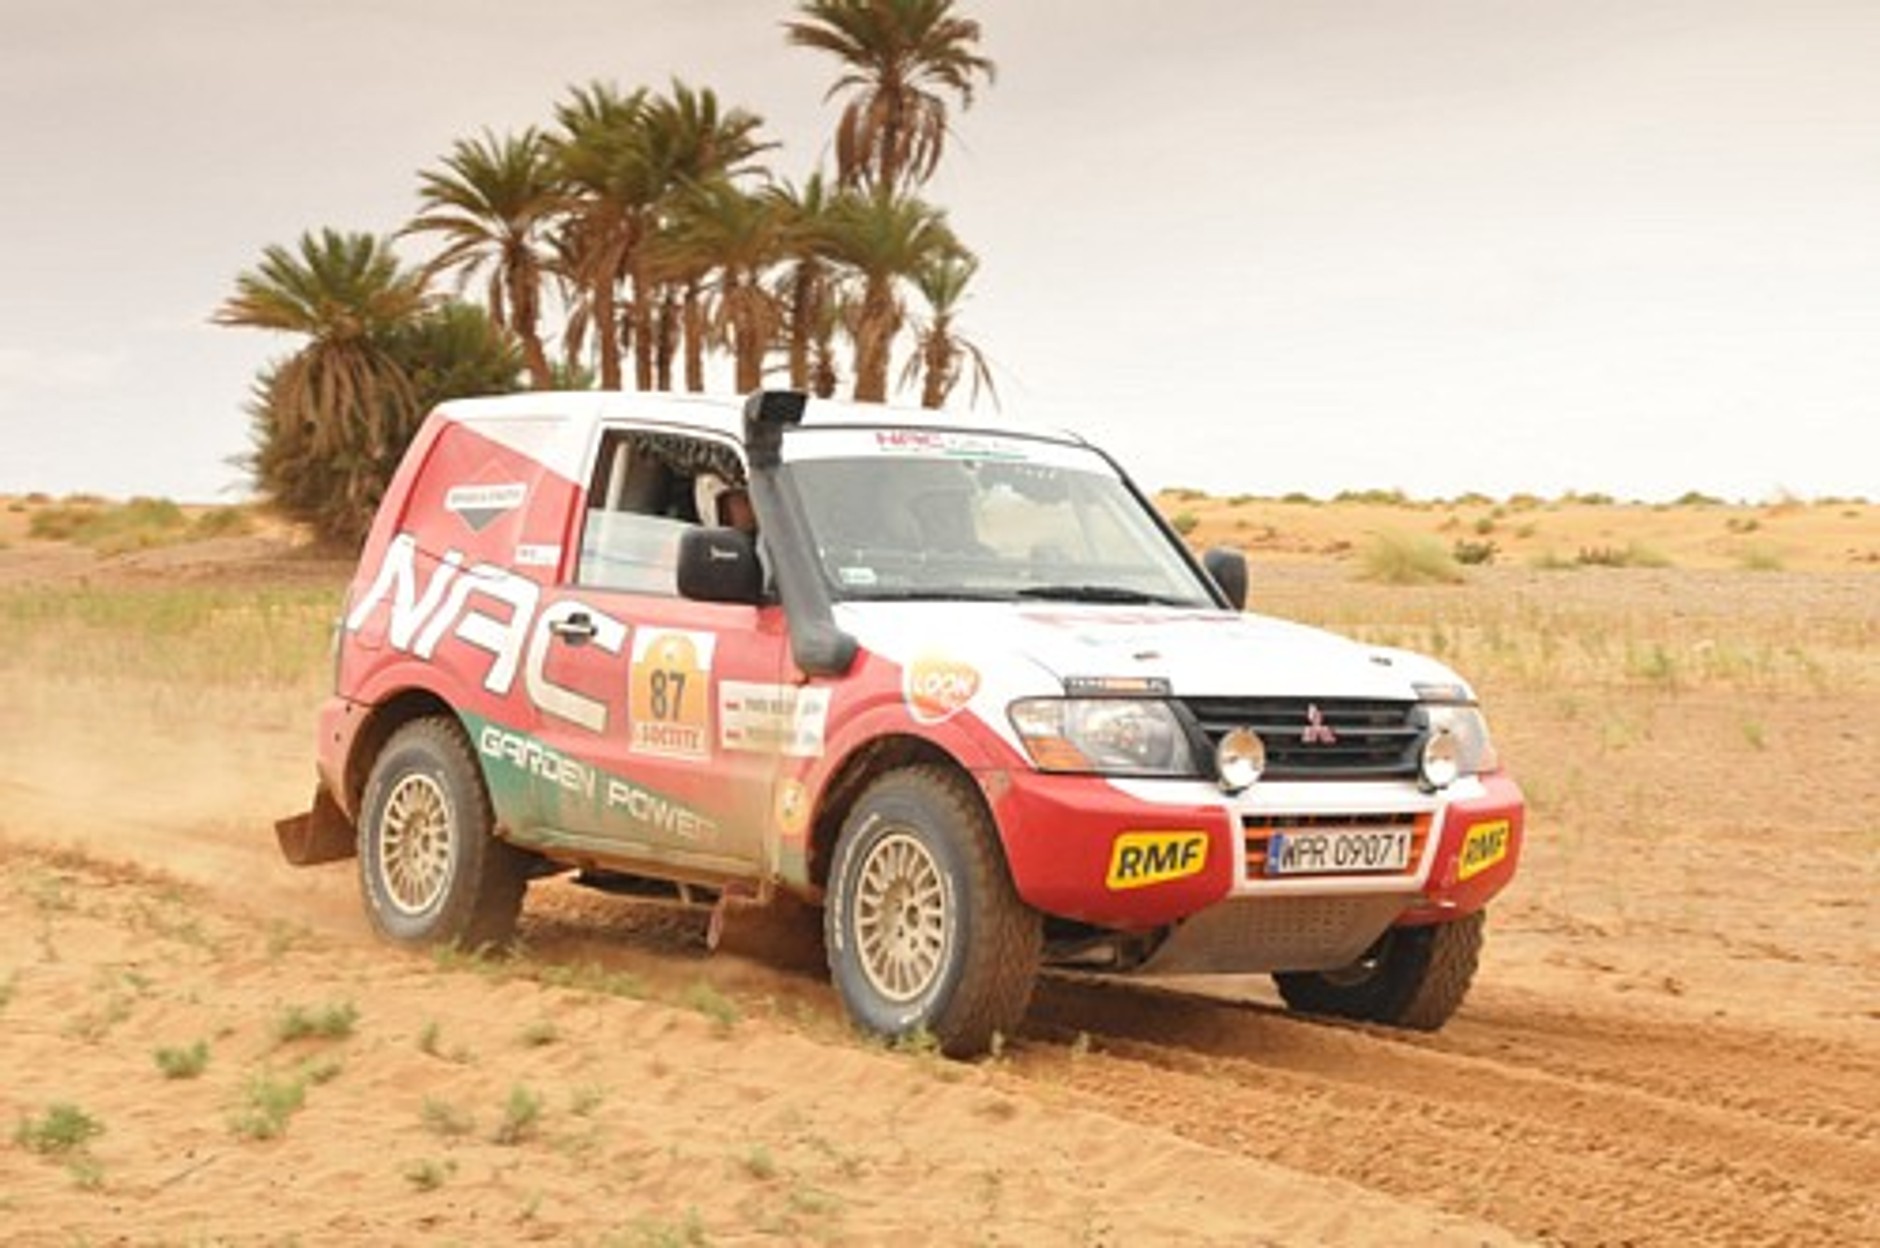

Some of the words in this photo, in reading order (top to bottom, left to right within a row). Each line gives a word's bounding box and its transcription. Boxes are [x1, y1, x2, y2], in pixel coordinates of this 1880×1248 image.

[346, 533, 628, 734] NAC
[650, 668, 686, 722] 87
[481, 725, 596, 799] GARDEN
[1117, 838, 1203, 878] RMF
[1281, 837, 1328, 869] WPR
[1333, 834, 1406, 866] 09071
[1464, 827, 1505, 866] RMF
